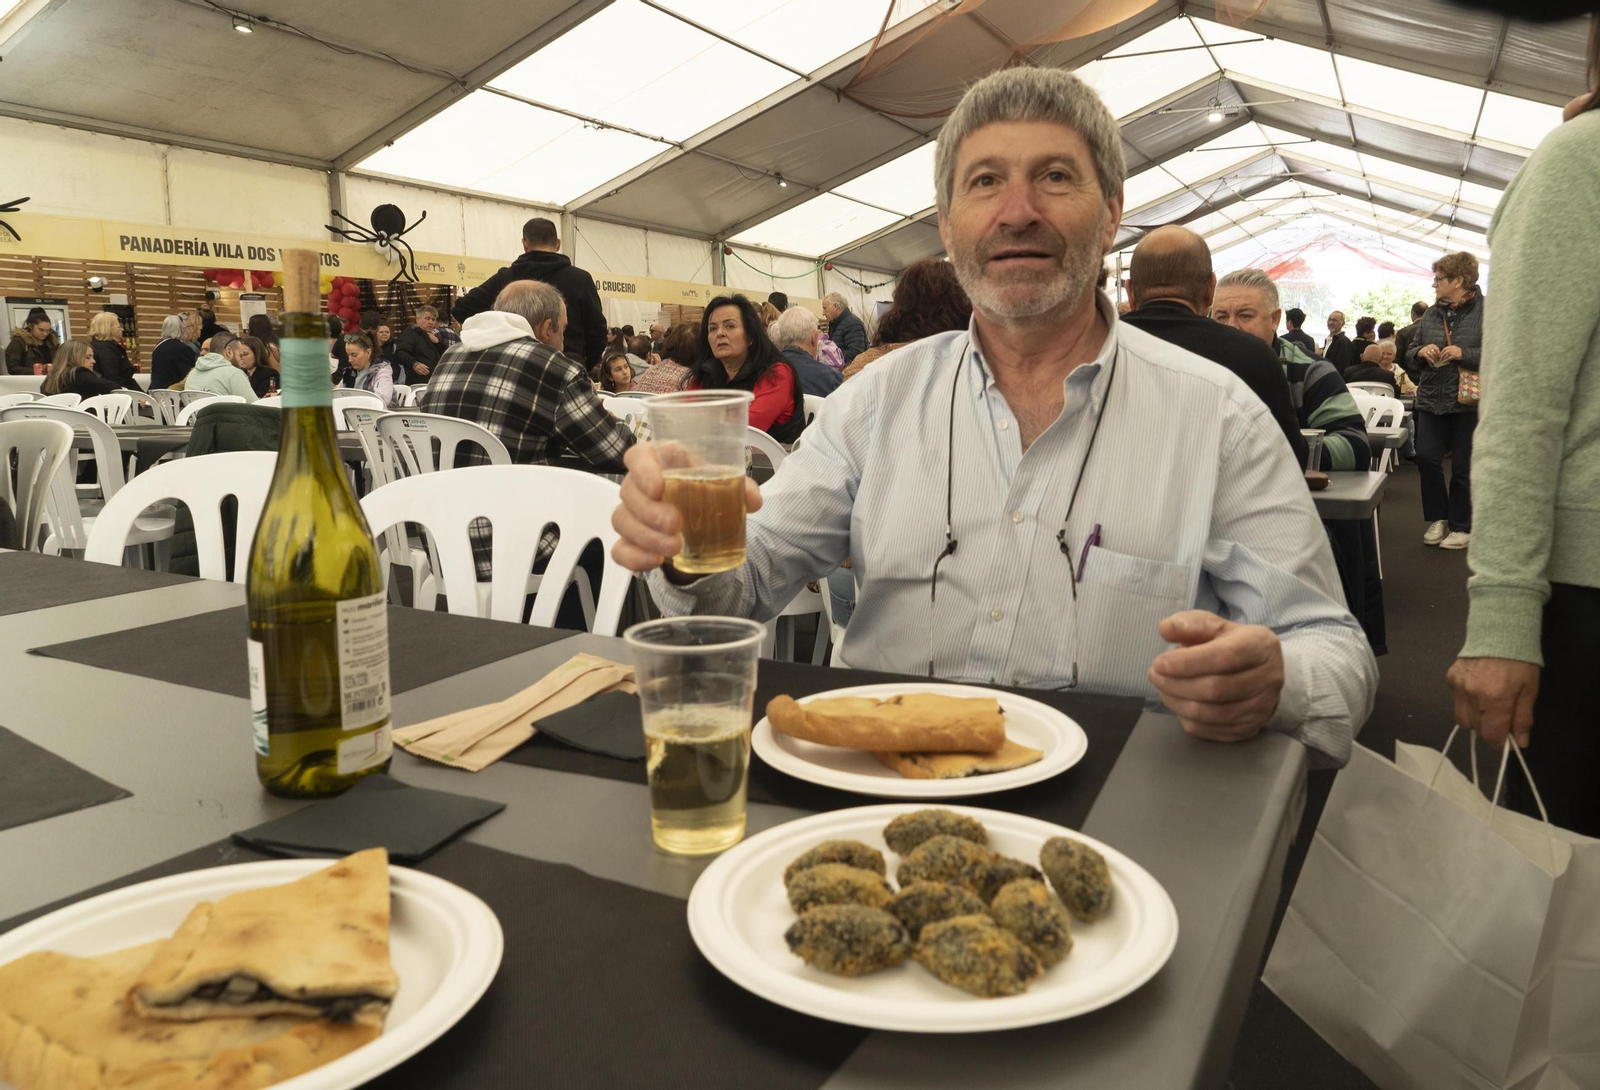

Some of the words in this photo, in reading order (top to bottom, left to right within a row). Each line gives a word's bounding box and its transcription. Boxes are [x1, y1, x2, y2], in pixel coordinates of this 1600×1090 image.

[119, 235, 210, 257] PANADERÍA
[213, 242, 244, 259] VILA
[247, 246, 276, 262] DOS
[602, 280, 636, 294] CRUCEIRO
